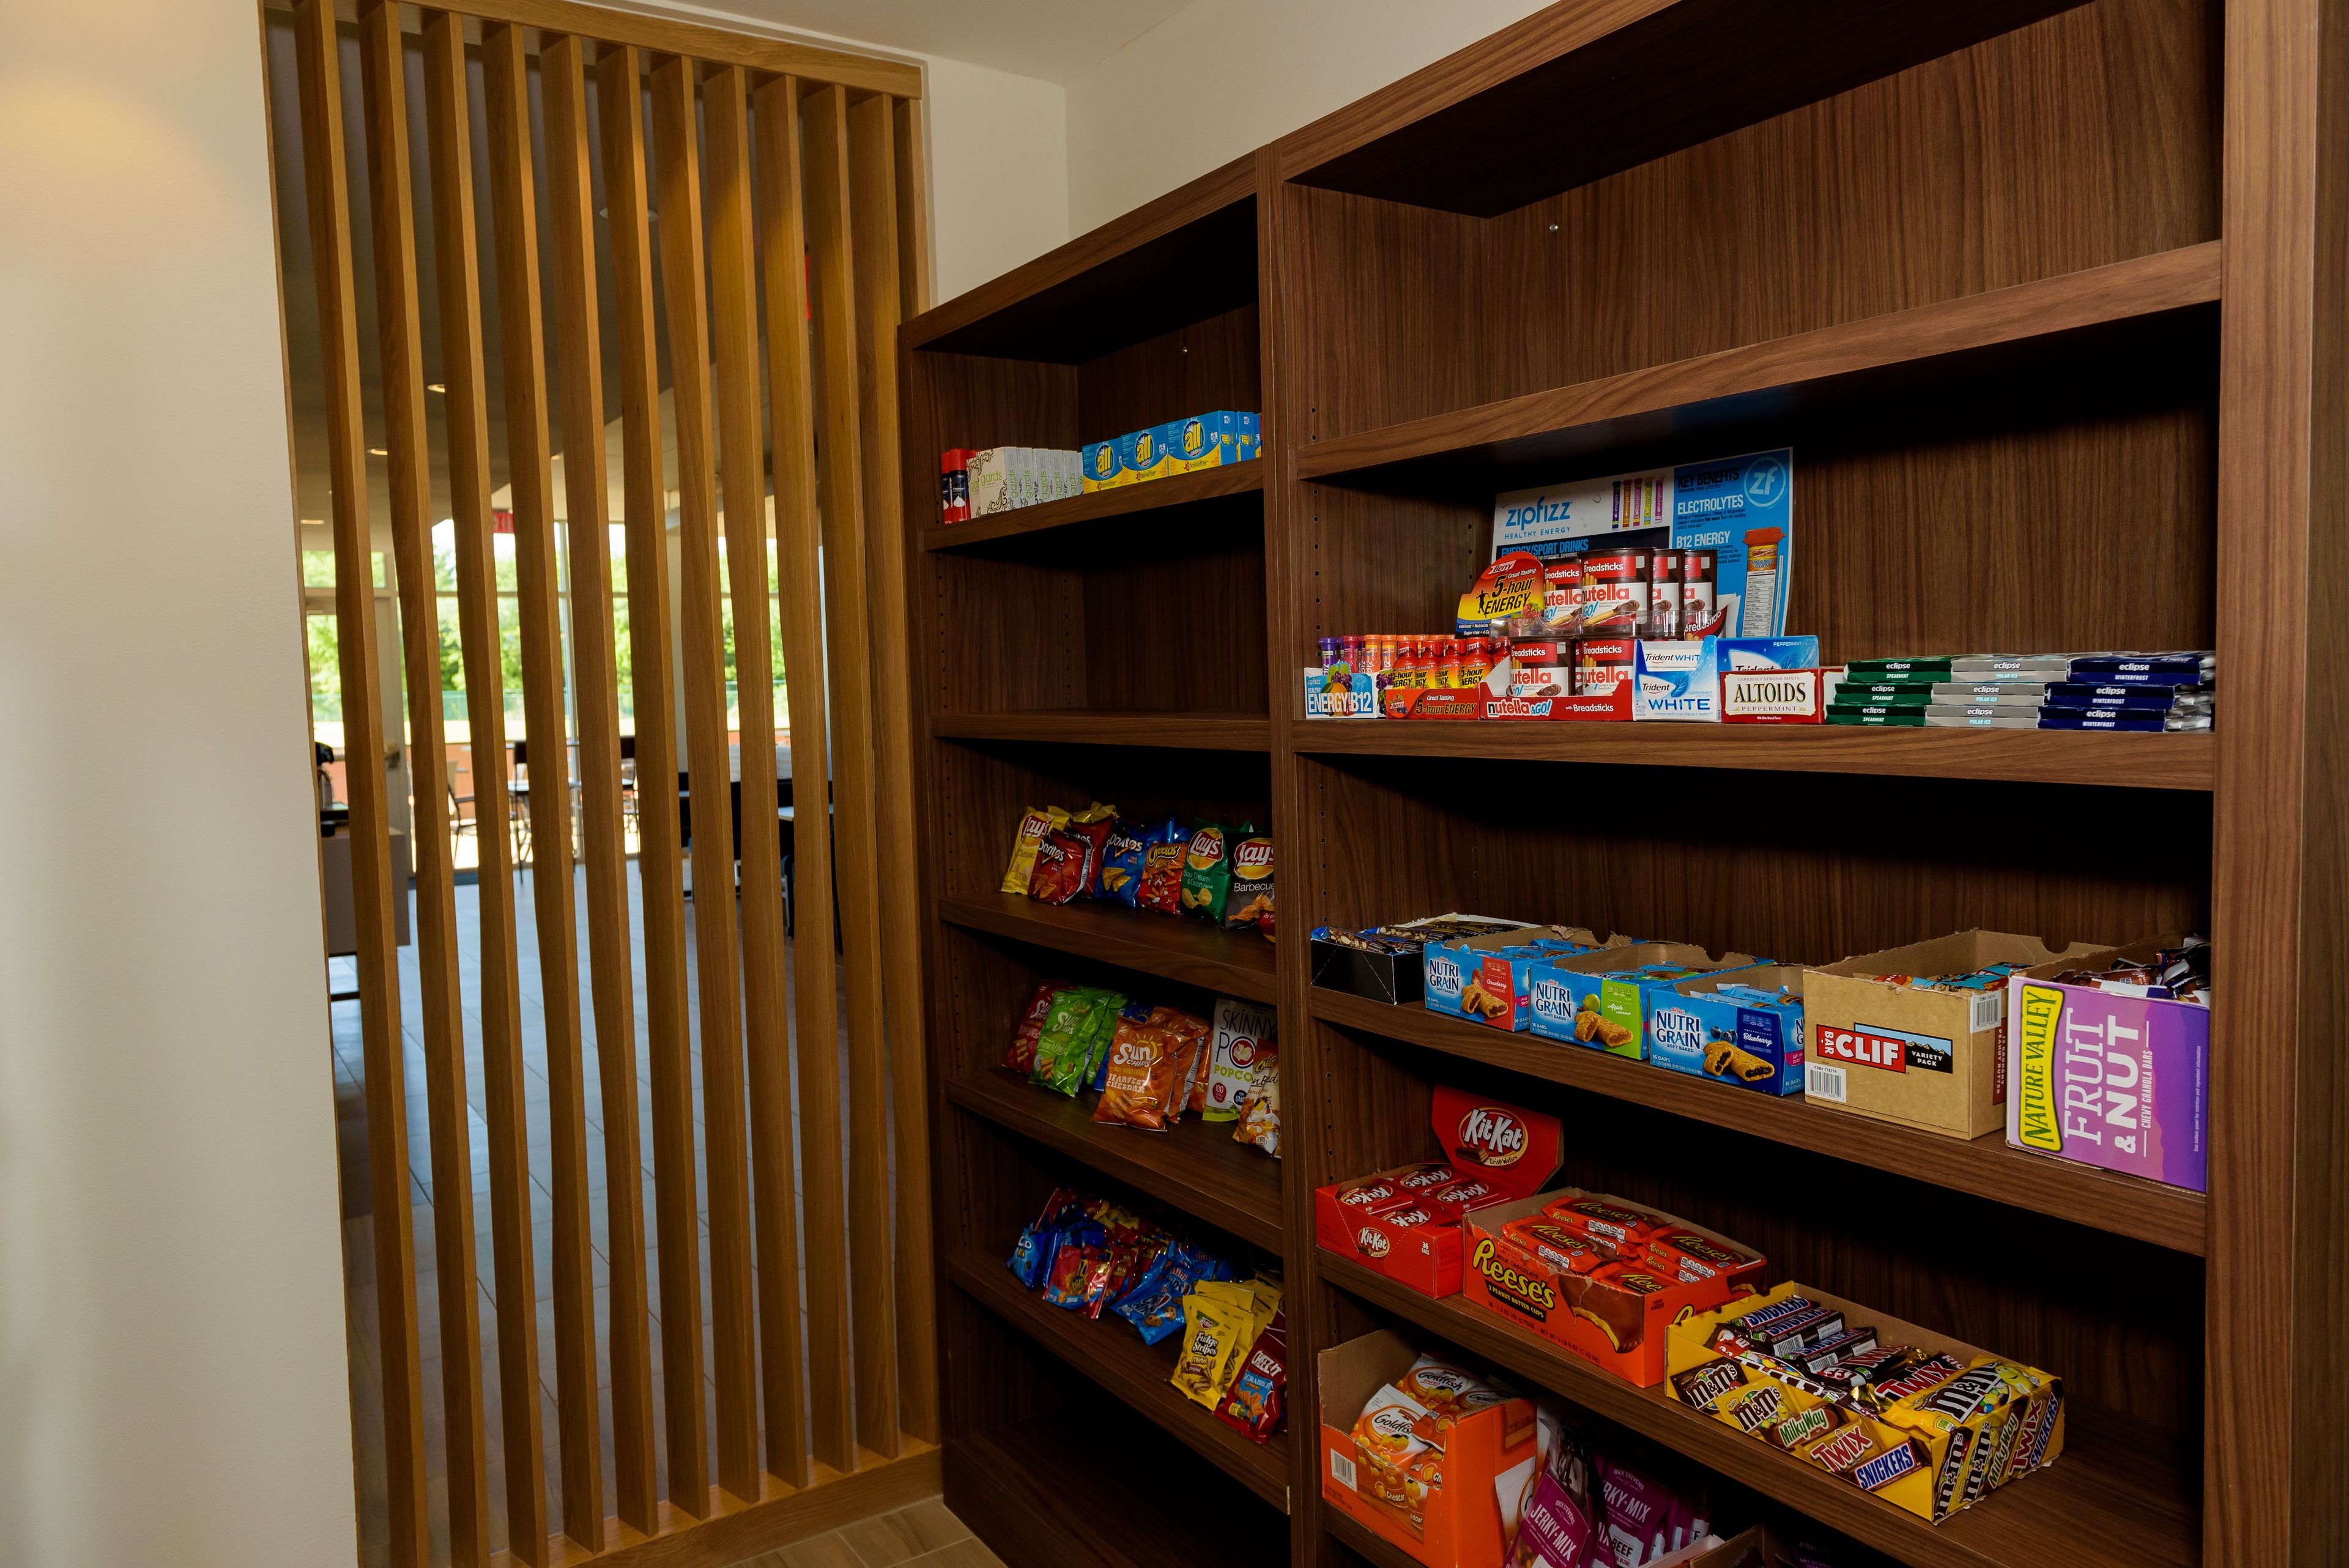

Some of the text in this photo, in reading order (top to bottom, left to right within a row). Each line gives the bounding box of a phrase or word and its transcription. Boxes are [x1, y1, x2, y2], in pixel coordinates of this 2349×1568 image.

[1185, 422, 1202, 452] all
[1136, 434, 1151, 464] all
[1097, 446, 1111, 474] all
[1187, 461, 1208, 470] stainlifter
[981, 470, 1002, 488] gards
[1008, 469, 1018, 499] gards
[1024, 470, 1033, 499] gards
[1041, 471, 1050, 499] gards
[1679, 467, 1740, 489] KEY BENEFITS
[1505, 496, 1571, 530] zipfizz
[1677, 494, 1743, 515] ELECTROLYTES
[1504, 526, 1570, 539] HEALTHY ENERGY
[1677, 530, 1731, 549] B12 ENERGY
[1559, 538, 1587, 554] DRINKS
[1493, 563, 1513, 573] Berry
[1520, 567, 1537, 576] Tasting
[1545, 569, 1579, 579] Breadsticks
[1584, 562, 1624, 573] Breadsticks
[1491, 574, 1535, 598] 5-hour
[1484, 592, 1531, 615] ENERGY
[1584, 644, 1622, 655] Breadsticks
[1645, 653, 1674, 663] Trident
[1642, 683, 1671, 692] Trident
[1734, 682, 1806, 703] ALTOIDS
[1308, 692, 1349, 713] ENERGY
[1351, 692, 1371, 712] B12
[1416, 699, 1477, 715] 5-hour ENERGY
[1488, 699, 1530, 715] nutella
[1573, 703, 1614, 713] Breadsticks
[1649, 699, 1710, 710] WHITE
[1038, 838, 1065, 862] Doritos
[1108, 833, 1143, 852] Doritos
[1189, 833, 1221, 856] Lay's
[1190, 879, 1203, 889] Onion
[1193, 872, 1210, 883] Cream
[1234, 882, 1274, 892] Barbecue
[1430, 959, 1458, 978] NUTRI
[1430, 974, 1459, 992] GRAIN
[1486, 978, 1507, 990] Strawberry
[1536, 982, 1570, 1003] NUTRI
[1536, 998, 1572, 1018] GRAIN
[1608, 1003, 1624, 1012] Apple
[1656, 1009, 1700, 1032] NUTRI
[1656, 1029, 1701, 1050] GRAIN
[1743, 1032, 1773, 1047] Blueberry
[1824, 1030, 1835, 1055] BAR
[1835, 1032, 1899, 1066] CLIF
[1113, 1042, 1152, 1065] Sun
[1911, 1050, 1943, 1061] VARIETY
[1917, 1057, 1937, 1067] PACK
[1126, 1059, 1151, 1068] CHIPS
[2024, 990, 2057, 1144] NATURE VALLEY
[2106, 1015, 2140, 1129] NUT
[1108, 1074, 1147, 1085] HARVEST
[2064, 1008, 2104, 1146] FRUIT
[1107, 1080, 1145, 1094] CHEDDAR
[2141, 1050, 2153, 1129] CHEWY GRANOLA BARS
[2115, 1135, 2137, 1154] &
[1503, 1156, 1518, 1164] Wafers
[1553, 1211, 1574, 1224] Reese's
[1509, 1232, 1527, 1247] Reese's
[1649, 1243, 1668, 1258] Reese's
[1496, 1254, 1539, 1279] MILK CHOCOLATE
[1646, 1255, 1667, 1271] Reese's
[1472, 1238, 1556, 1310] Reese's
[1493, 1287, 1510, 1301] PEANUT
[1512, 1296, 1530, 1310] BUTTER
[1531, 1306, 1544, 1318] CUPS
[1696, 1306, 1709, 1315] MILK
[1748, 1297, 1810, 1328] SNICKERS
[1193, 1341, 1217, 1356] Stripes
[1196, 1332, 1218, 1347] Fudge
[1243, 1373, 1271, 1389] SCRABBLE
[1418, 1372, 1464, 1392] Goldfish
[1687, 1362, 1738, 1410] m&m's
[1734, 1385, 1782, 1434] m&m's
[1379, 1425, 1396, 1433] BAKED
[2030, 1392, 2058, 1469] SNICKERS
[1855, 1442, 1916, 1492] SNICKERS
[1625, 1472, 1644, 1491] STEVENS
[1386, 1490, 1405, 1502] Cheddar
[1562, 1504, 1575, 1525] STEVENS
